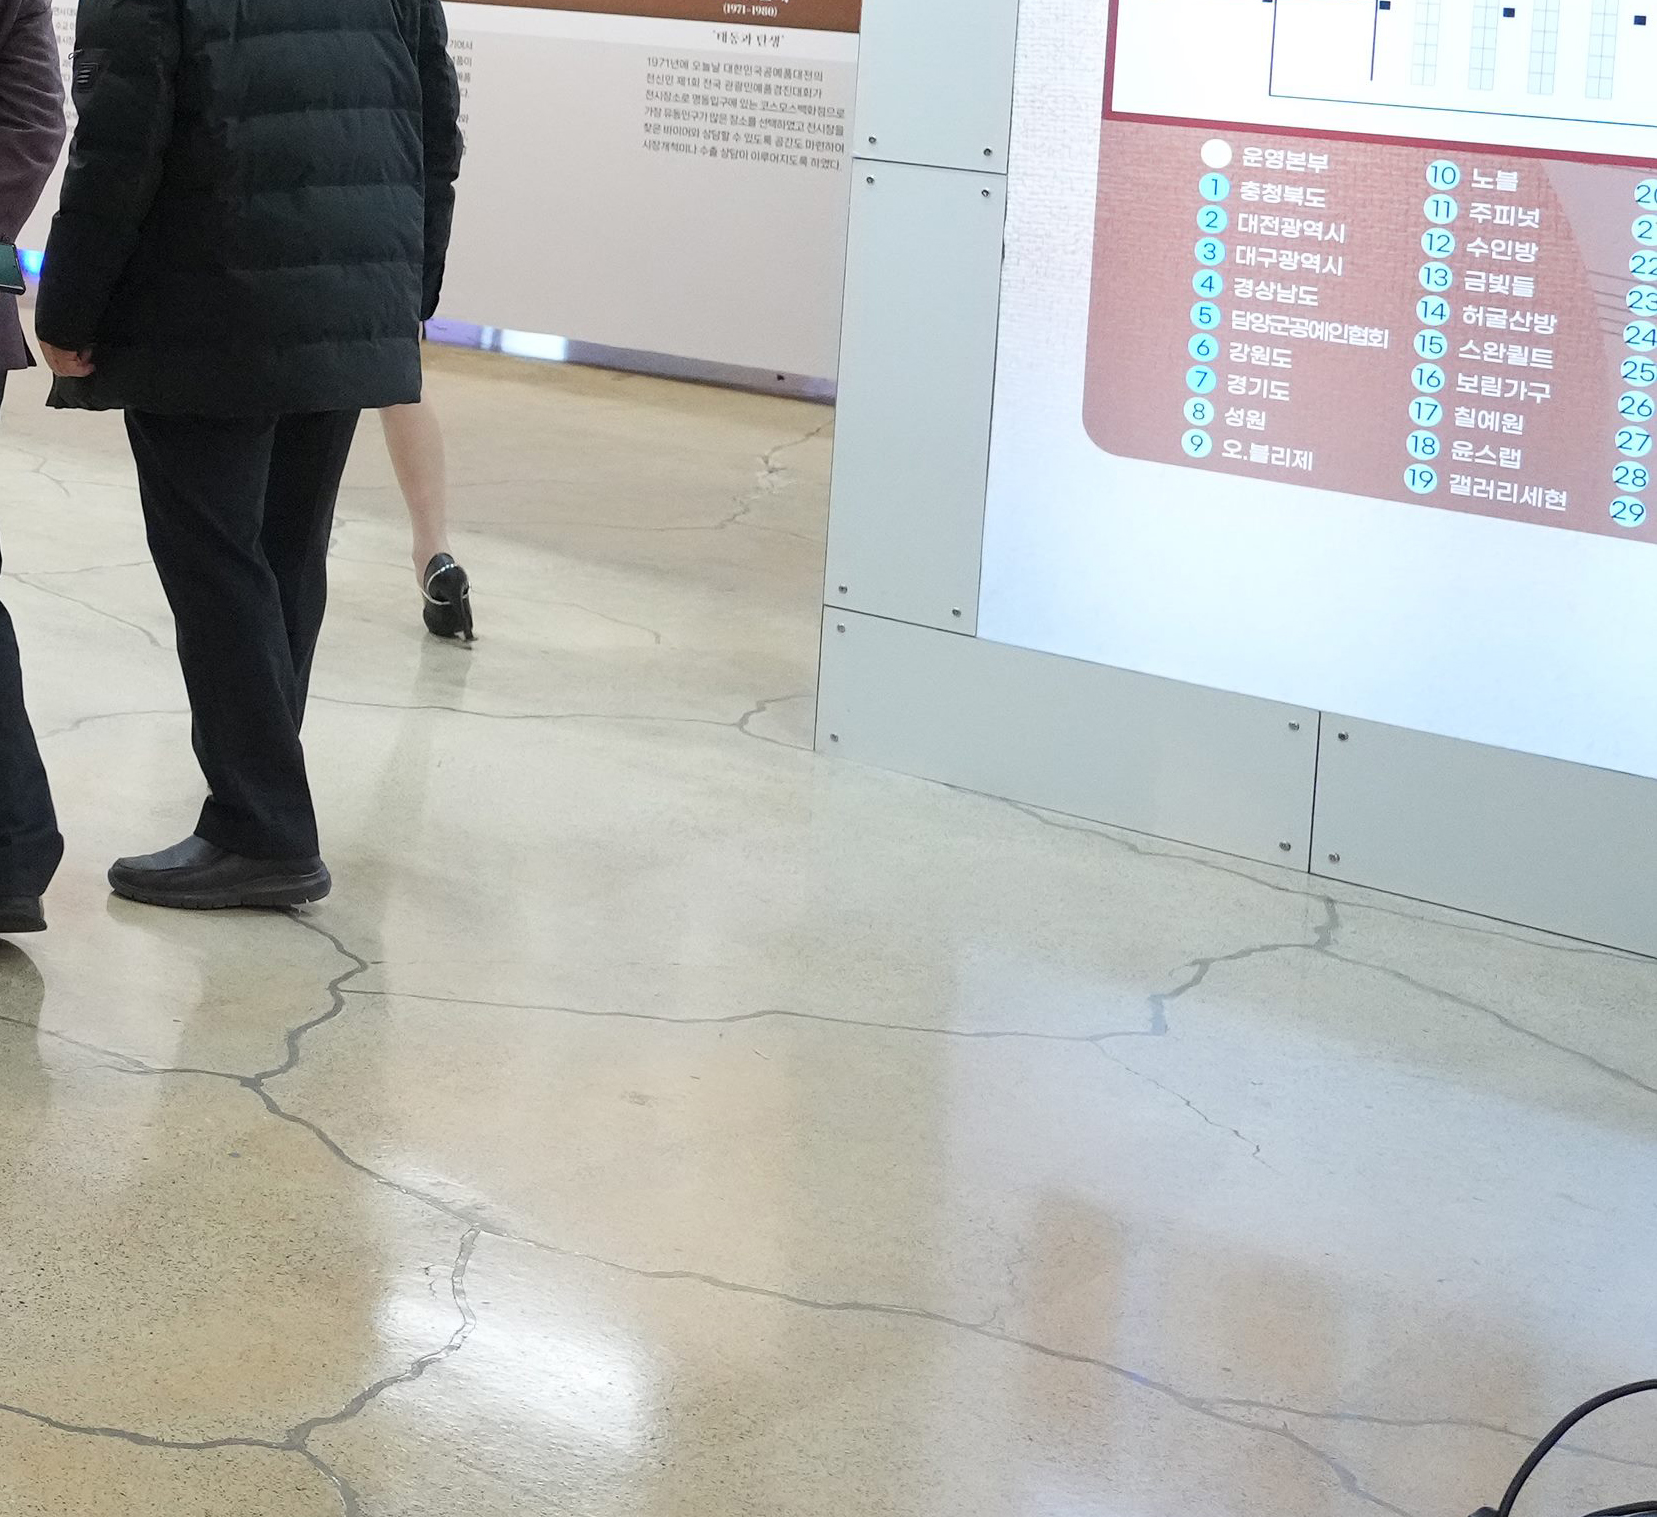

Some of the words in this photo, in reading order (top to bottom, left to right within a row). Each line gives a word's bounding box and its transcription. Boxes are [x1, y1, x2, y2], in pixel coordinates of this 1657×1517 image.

[1242, 146, 1329, 174] 운영본부
[1431, 165, 1457, 185] 10
[1211, 178, 1219, 196] 1
[1239, 180, 1326, 208] 충청북도
[1205, 210, 1218, 229] 2
[1237, 212, 1345, 244] 대전광역시
[1432, 199, 1450, 219] 11
[1468, 202, 1540, 229] 주피넛
[1637, 220, 1657, 240] 2
[1203, 243, 1216, 260] 3
[1235, 245, 1343, 277] 대구광역시
[1427, 233, 1451, 253] 12
[1466, 236, 1539, 264] 수인방
[1200, 275, 1215, 293] 4
[1233, 277, 1319, 307] 경상남도
[1423, 266, 1448, 287] 13
[1198, 306, 1212, 324] 5
[1421, 300, 1447, 321] 14
[1462, 304, 1558, 335] 허굴산방
[1624, 325, 1657, 346] 24
[1196, 339, 1210, 356] 6
[1229, 341, 1292, 369] 강원도
[1418, 334, 1443, 355] 15
[1458, 339, 1554, 370] 스완퀼트
[1195, 370, 1208, 388] 7
[1227, 373, 1290, 401] 경기도
[1416, 367, 1441, 388] 16
[1455, 372, 1551, 404] 보림가구
[1622, 360, 1656, 382] 25
[1192, 402, 1205, 420] 8
[1224, 406, 1266, 431] 성원
[1414, 401, 1438, 421] 17
[1453, 405, 1524, 435] 칠예원
[1619, 395, 1653, 418] 26
[1190, 434, 1204, 452] 9
[1411, 434, 1435, 456] 18
[1450, 439, 1522, 470] 윤스랩
[1617, 430, 1651, 453] 27
[1409, 468, 1434, 489] 19
[1448, 472, 1567, 512] 갤러리세현
[1614, 465, 1647, 488] 28
[1611, 500, 1645, 522] 29
